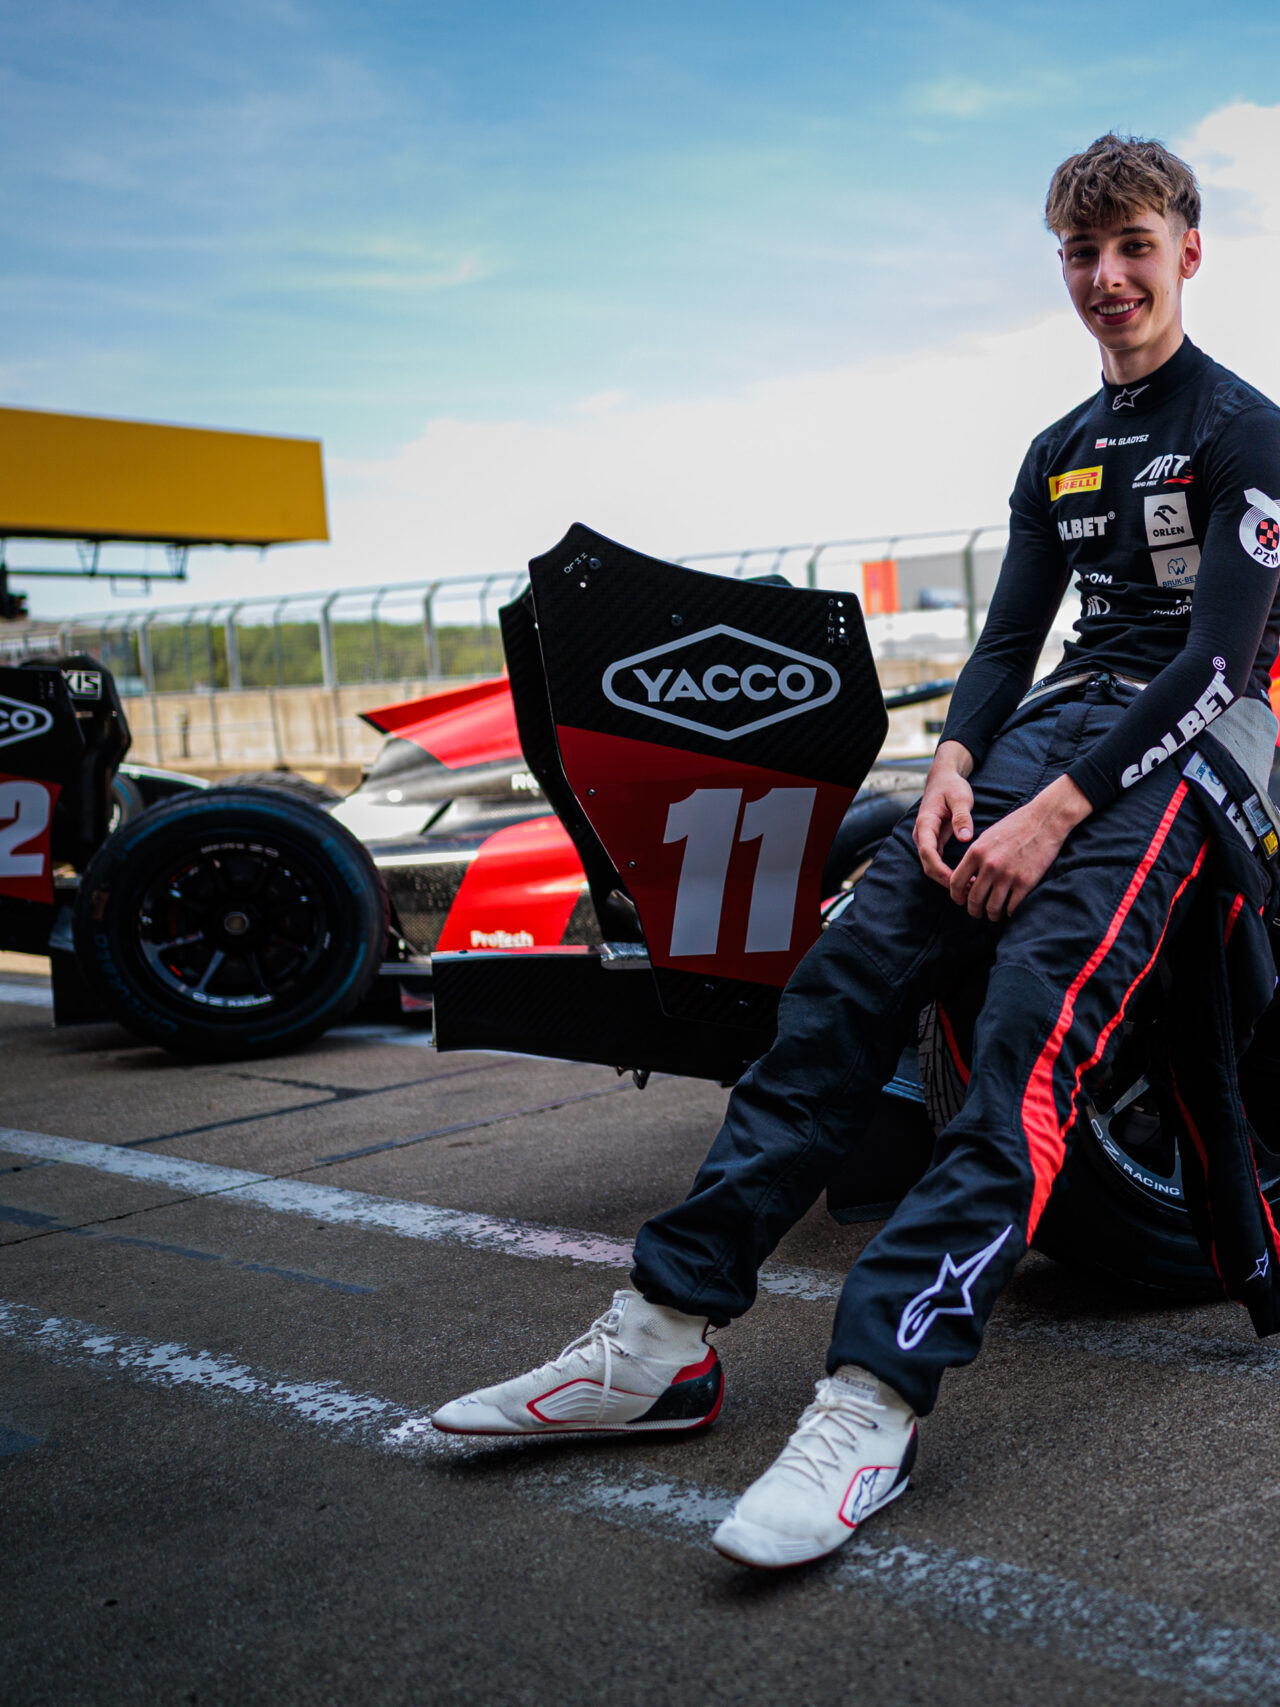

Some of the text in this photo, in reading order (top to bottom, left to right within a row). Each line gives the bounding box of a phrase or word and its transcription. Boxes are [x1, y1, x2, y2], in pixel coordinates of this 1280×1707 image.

[1133, 453, 1190, 481] ART
[1055, 471, 1098, 495] PIRELLI
[1152, 525, 1185, 538] ORLEN
[1252, 546, 1279, 566] PZM
[632, 664, 815, 703] YACCO
[662, 787, 818, 957] 11
[1122, 1162, 1181, 1197] RACING
